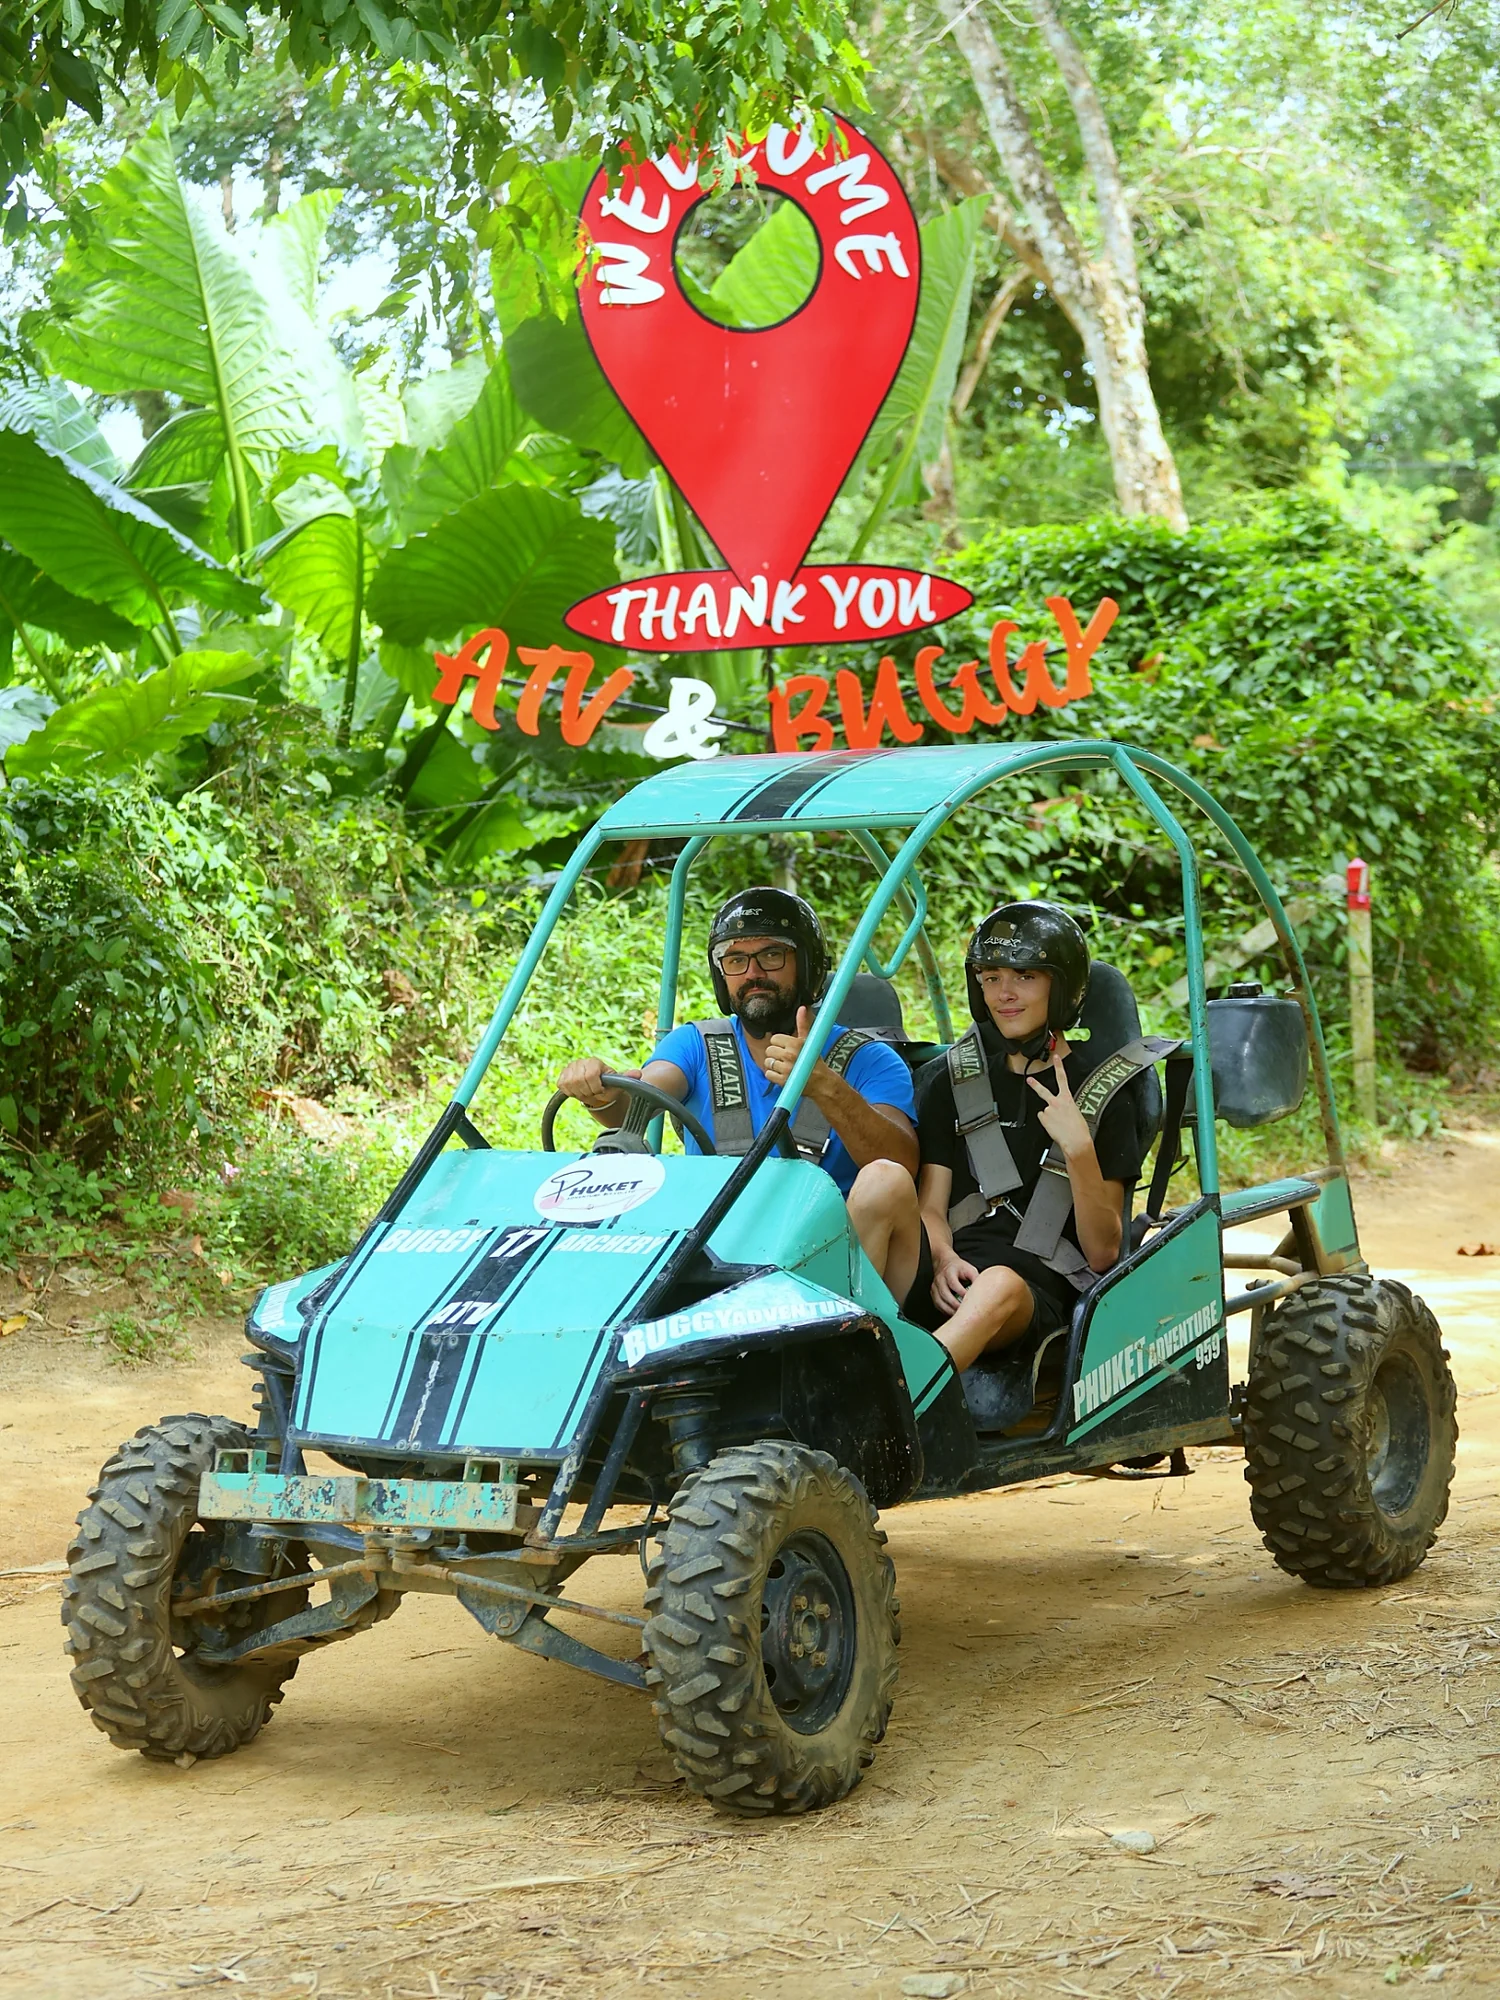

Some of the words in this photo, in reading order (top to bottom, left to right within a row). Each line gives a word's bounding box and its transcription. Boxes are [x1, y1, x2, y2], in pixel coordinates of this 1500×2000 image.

[593, 107, 911, 305] WELOME
[606, 574, 806, 642] THANK
[820, 574, 936, 630] YOU
[434, 628, 636, 747] ATV
[643, 677, 727, 760] &
[768, 596, 1120, 751] BUGGY
[716, 1038, 742, 1107] TAKATA
[831, 1035, 870, 1073] TAKA
[960, 1038, 980, 1078] TAKATA
[1100, 1057, 1122, 1074] TAKATA
[712, 1061, 724, 1107] CORPORATION
[1075, 1072, 1103, 1107] CORPORATIO
[1081, 1063, 1137, 1116] TAKATA
[541, 1169, 643, 1203] PHUKET
[374, 1229, 492, 1254] BUGGY
[489, 1229, 550, 1258] 17
[551, 1234, 670, 1255] ARCHERY
[425, 1301, 503, 1325] ATV
[1073, 1336, 1146, 1423] PHUKET
[1147, 1300, 1221, 1372] ADVENTURE
[1195, 1333, 1221, 1370] 959
